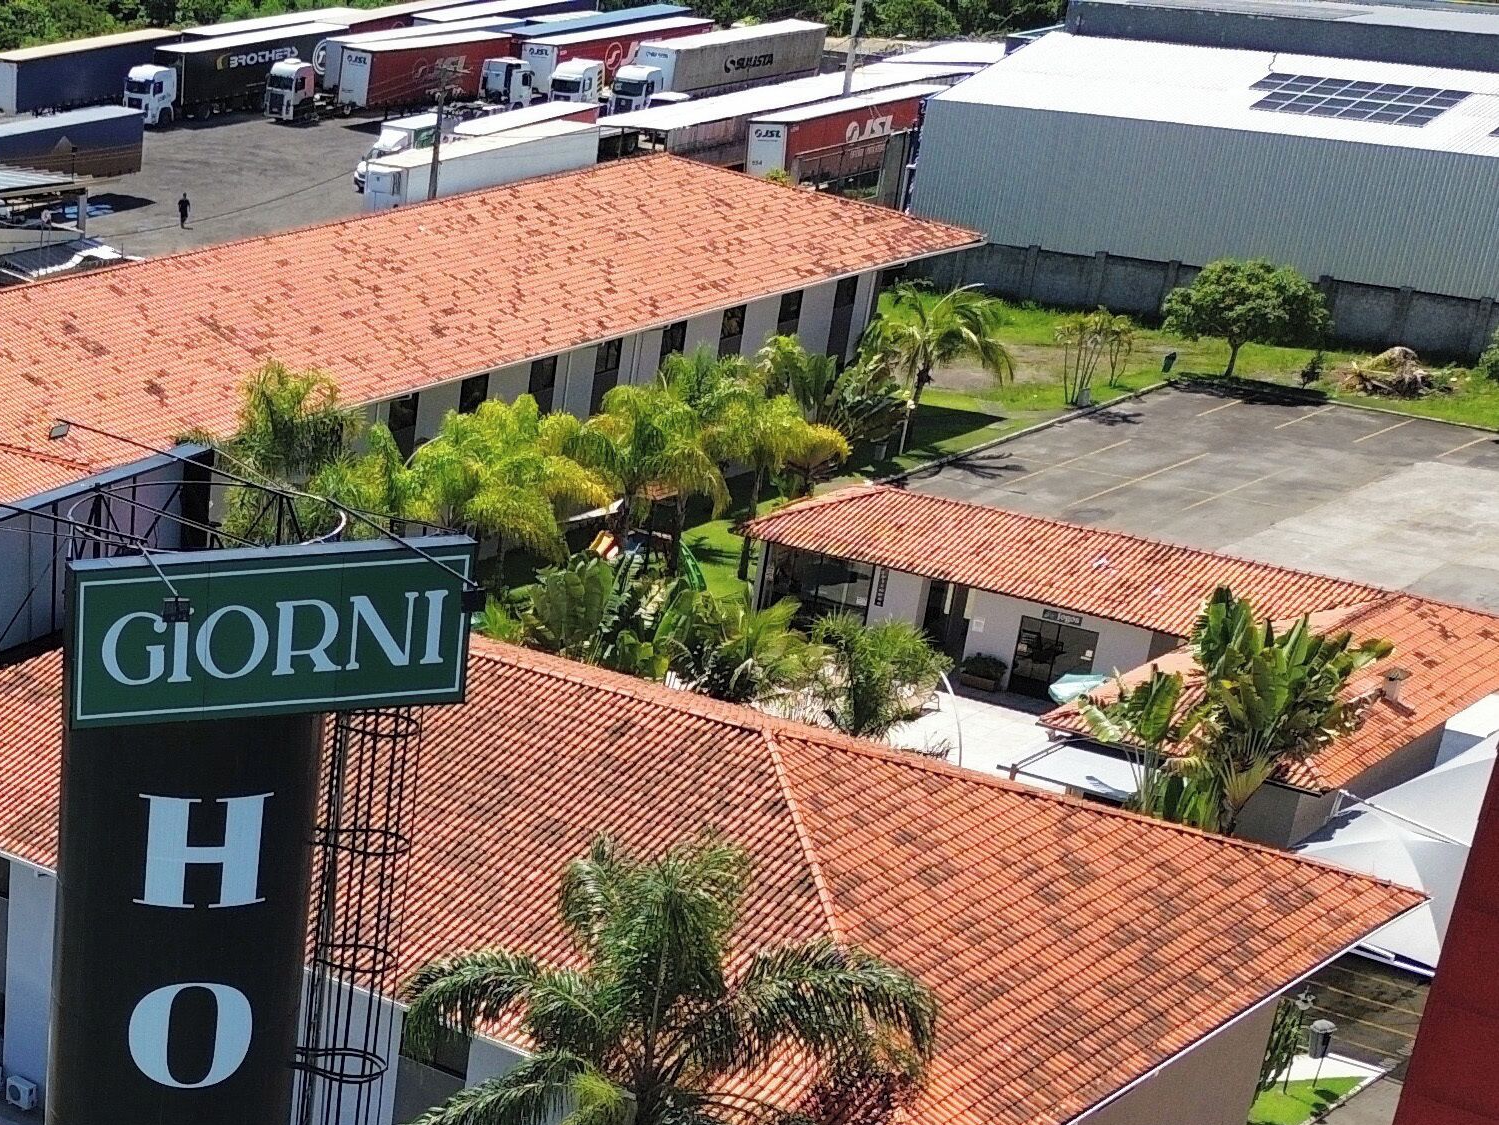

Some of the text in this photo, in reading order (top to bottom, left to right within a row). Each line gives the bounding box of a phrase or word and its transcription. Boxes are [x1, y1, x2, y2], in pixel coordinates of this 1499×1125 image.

[229, 46, 299, 68] BROTHERS
[762, 129, 782, 138] JSL
[858, 115, 895, 140] JSL
[102, 589, 449, 686] GIORNI
